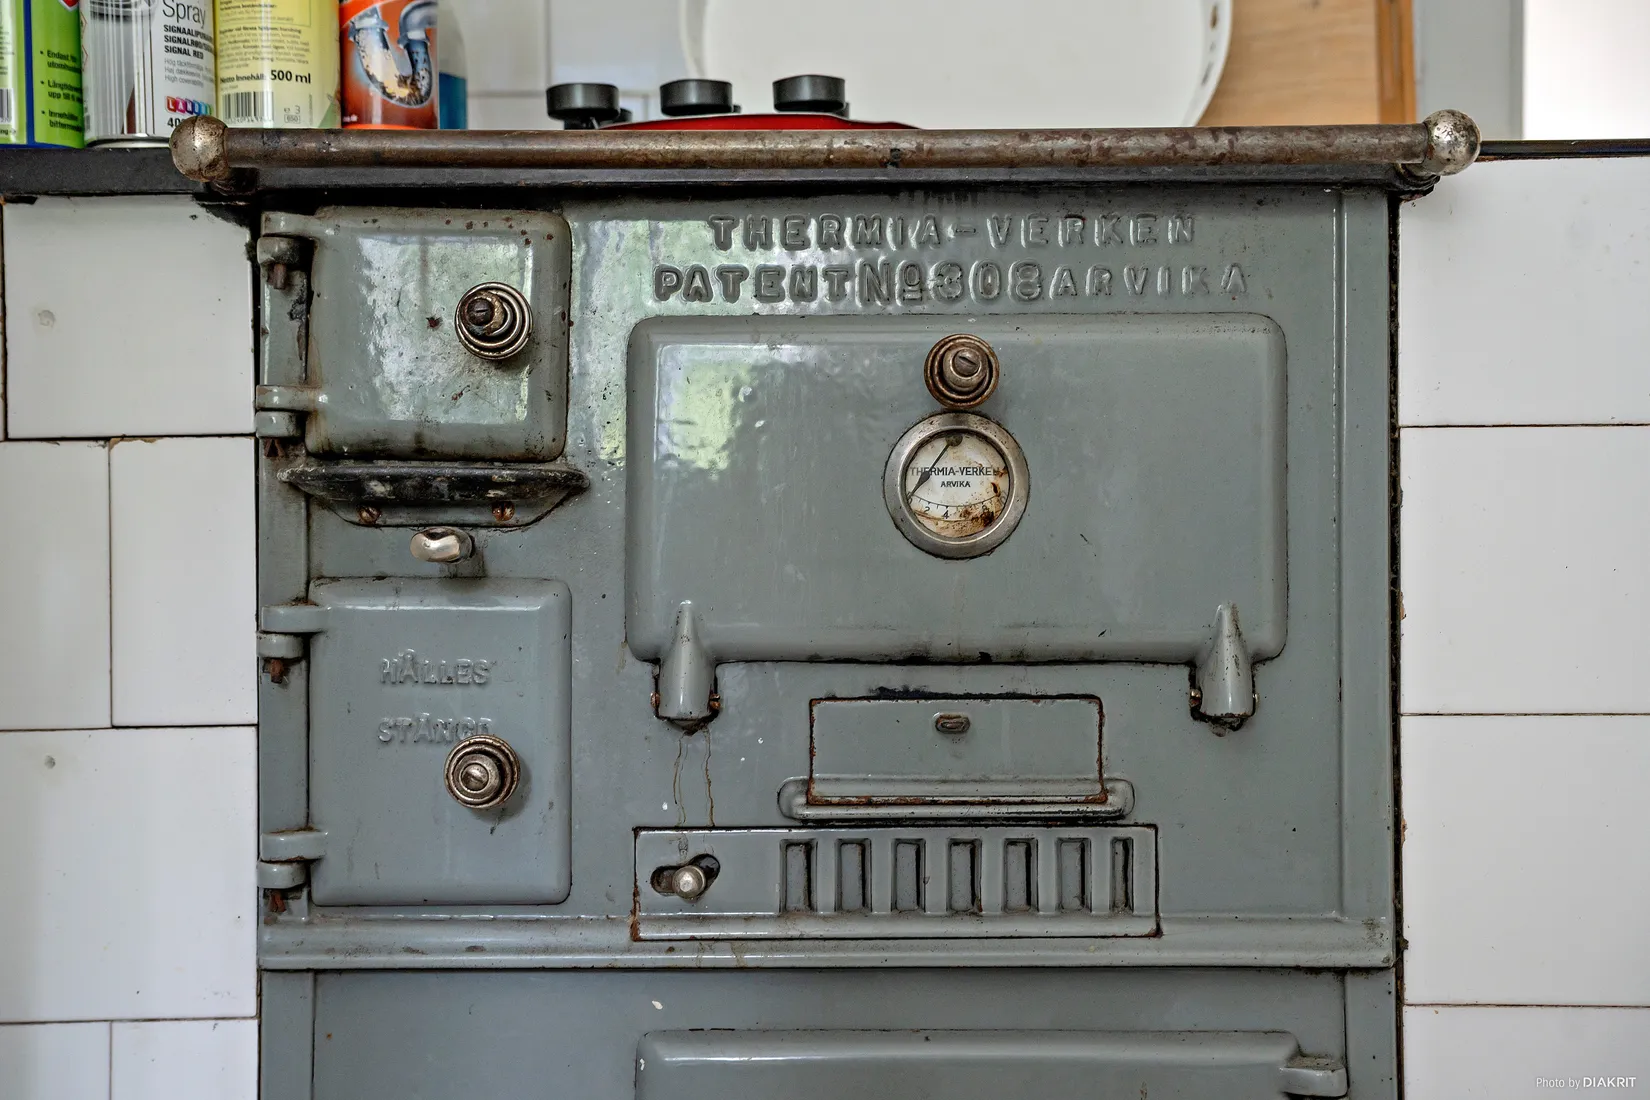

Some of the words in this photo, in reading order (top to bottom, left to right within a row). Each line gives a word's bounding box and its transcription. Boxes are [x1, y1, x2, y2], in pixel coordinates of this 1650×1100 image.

[162, 0, 206, 29] Spray
[164, 45, 192, 57] SIGNAL
[193, 49, 204, 60] RED
[270, 69, 293, 82] 500
[295, 73, 311, 84] ml
[654, 263, 851, 302] PATENT
[1049, 262, 1248, 298] ARVIKA
[940, 480, 971, 488] ARVIKA
[943, 510, 950, 519] 4
[380, 648, 490, 685] HÅLLES
